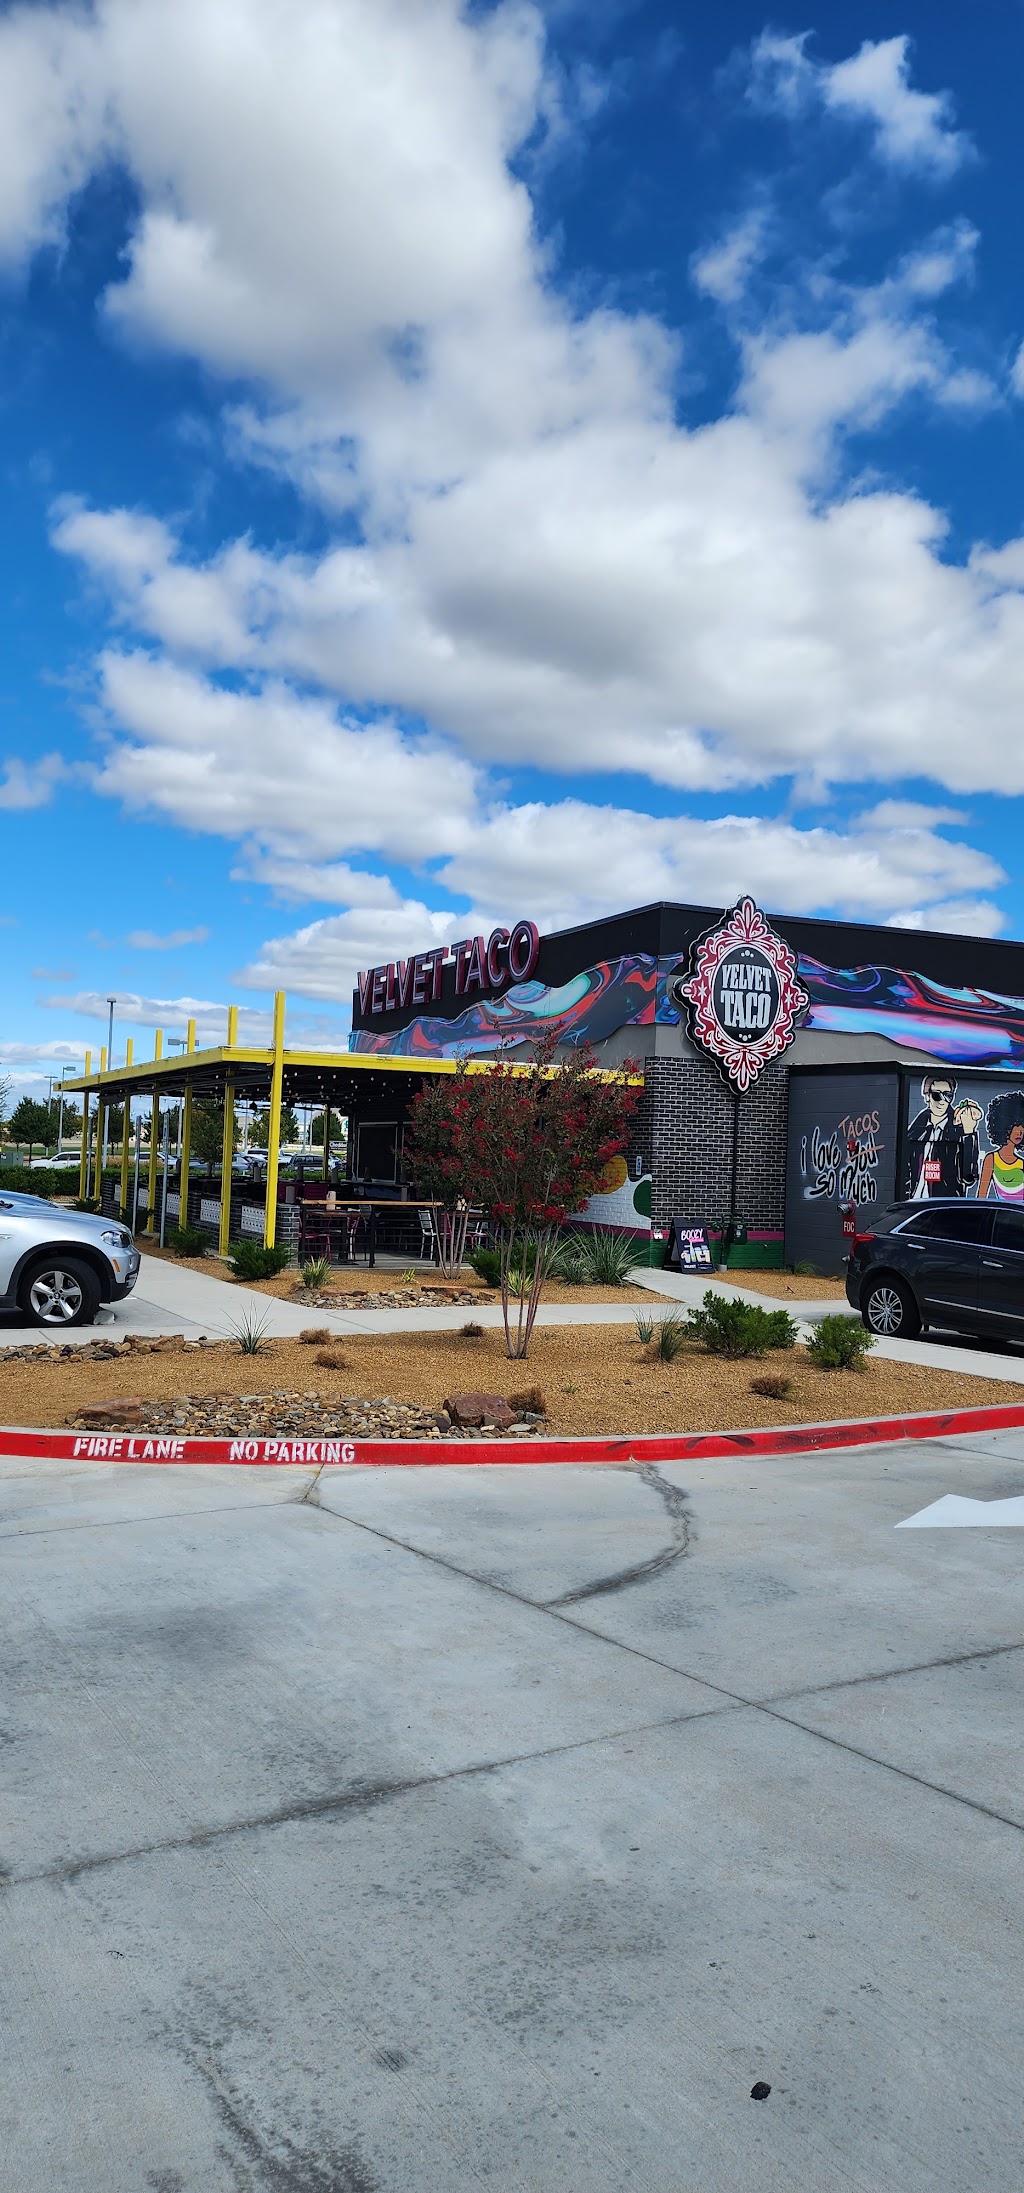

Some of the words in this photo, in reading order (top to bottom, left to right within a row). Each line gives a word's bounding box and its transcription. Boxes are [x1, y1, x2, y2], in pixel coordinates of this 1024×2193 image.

[357, 946, 449, 1016] VELVET
[450, 920, 540, 995] TACO
[722, 964, 772, 991] VELVET
[721, 990, 771, 1028] TACO
[838, 1110, 880, 1138] TACOS
[812, 1126, 841, 1173] love
[925, 1162, 941, 1172] RISER
[925, 1171, 941, 1181] ROOM
[809, 1172, 836, 1198] so
[840, 1166, 877, 1206] much
[681, 1228, 703, 1241] BOOZY
[73, 1437, 124, 1457] FIRE
[128, 1439, 186, 1460] LANE
[229, 1441, 258, 1461] NO
[264, 1442, 356, 1463] PARKING
